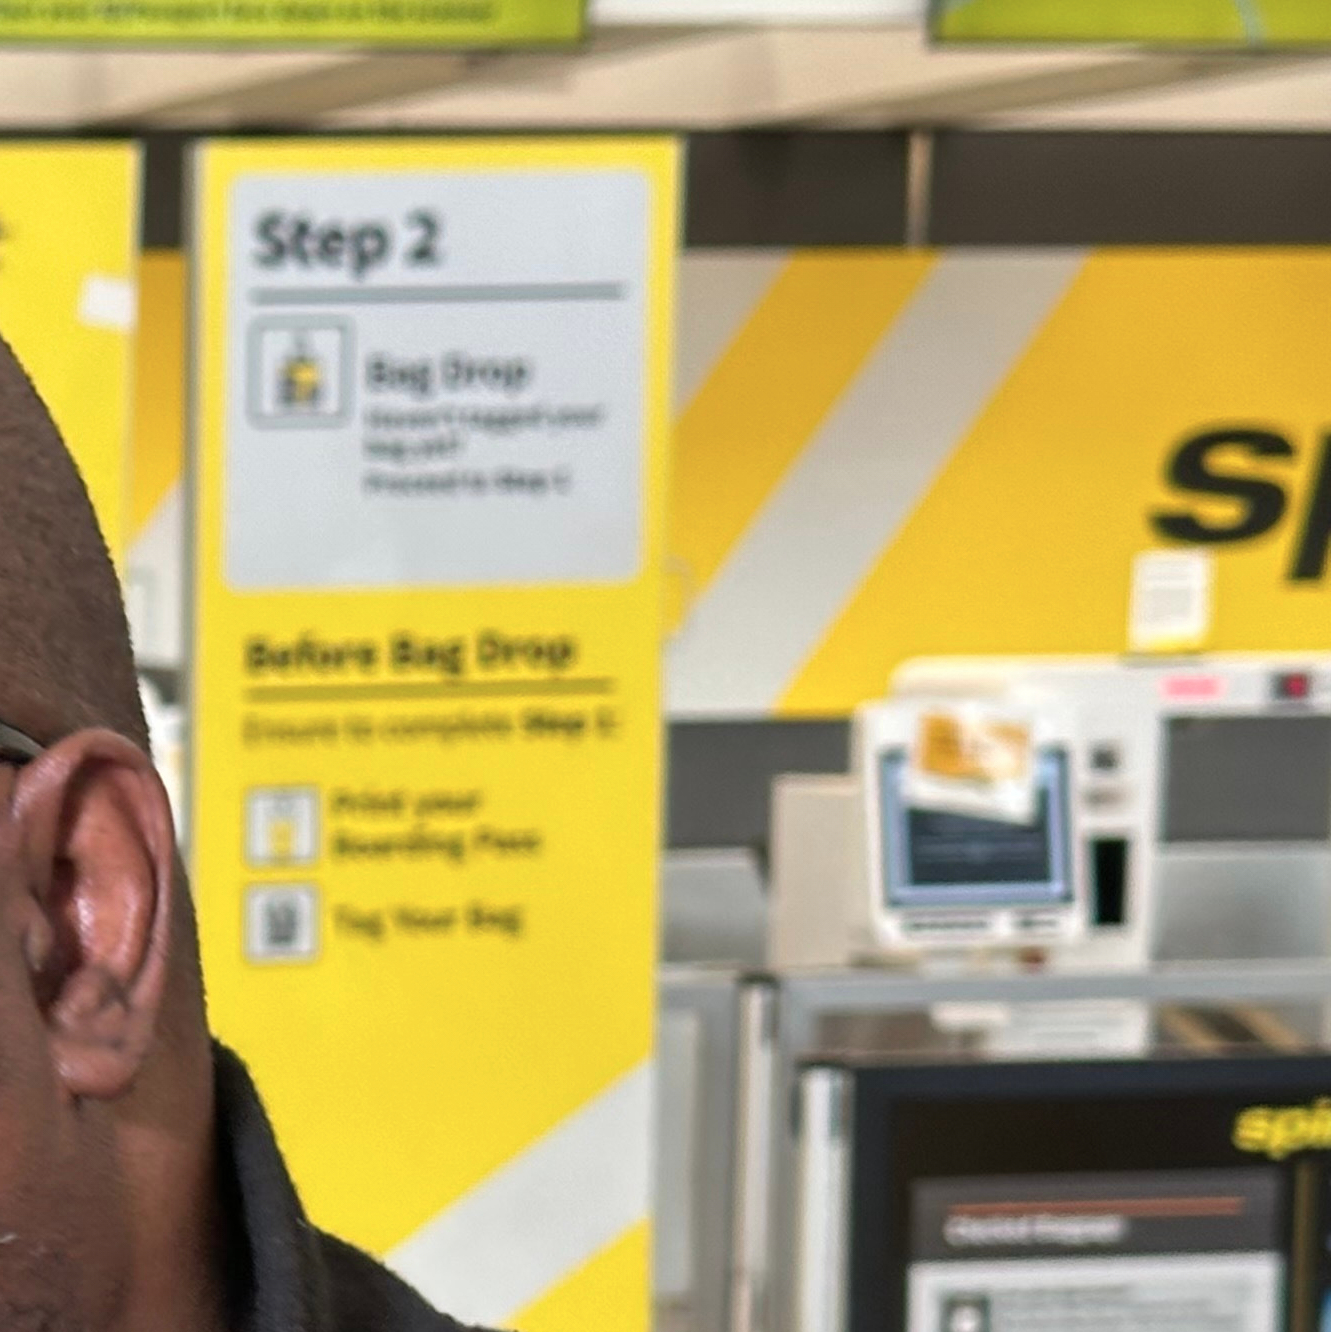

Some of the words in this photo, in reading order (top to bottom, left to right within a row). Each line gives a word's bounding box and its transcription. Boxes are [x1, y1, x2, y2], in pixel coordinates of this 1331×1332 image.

[253, 209, 391, 280] Step
[404, 205, 441, 268] 2
[440, 352, 530, 396] Drop
[246, 633, 377, 674] Before
[389, 632, 464, 679] Bag
[475, 630, 576, 674] Drop
